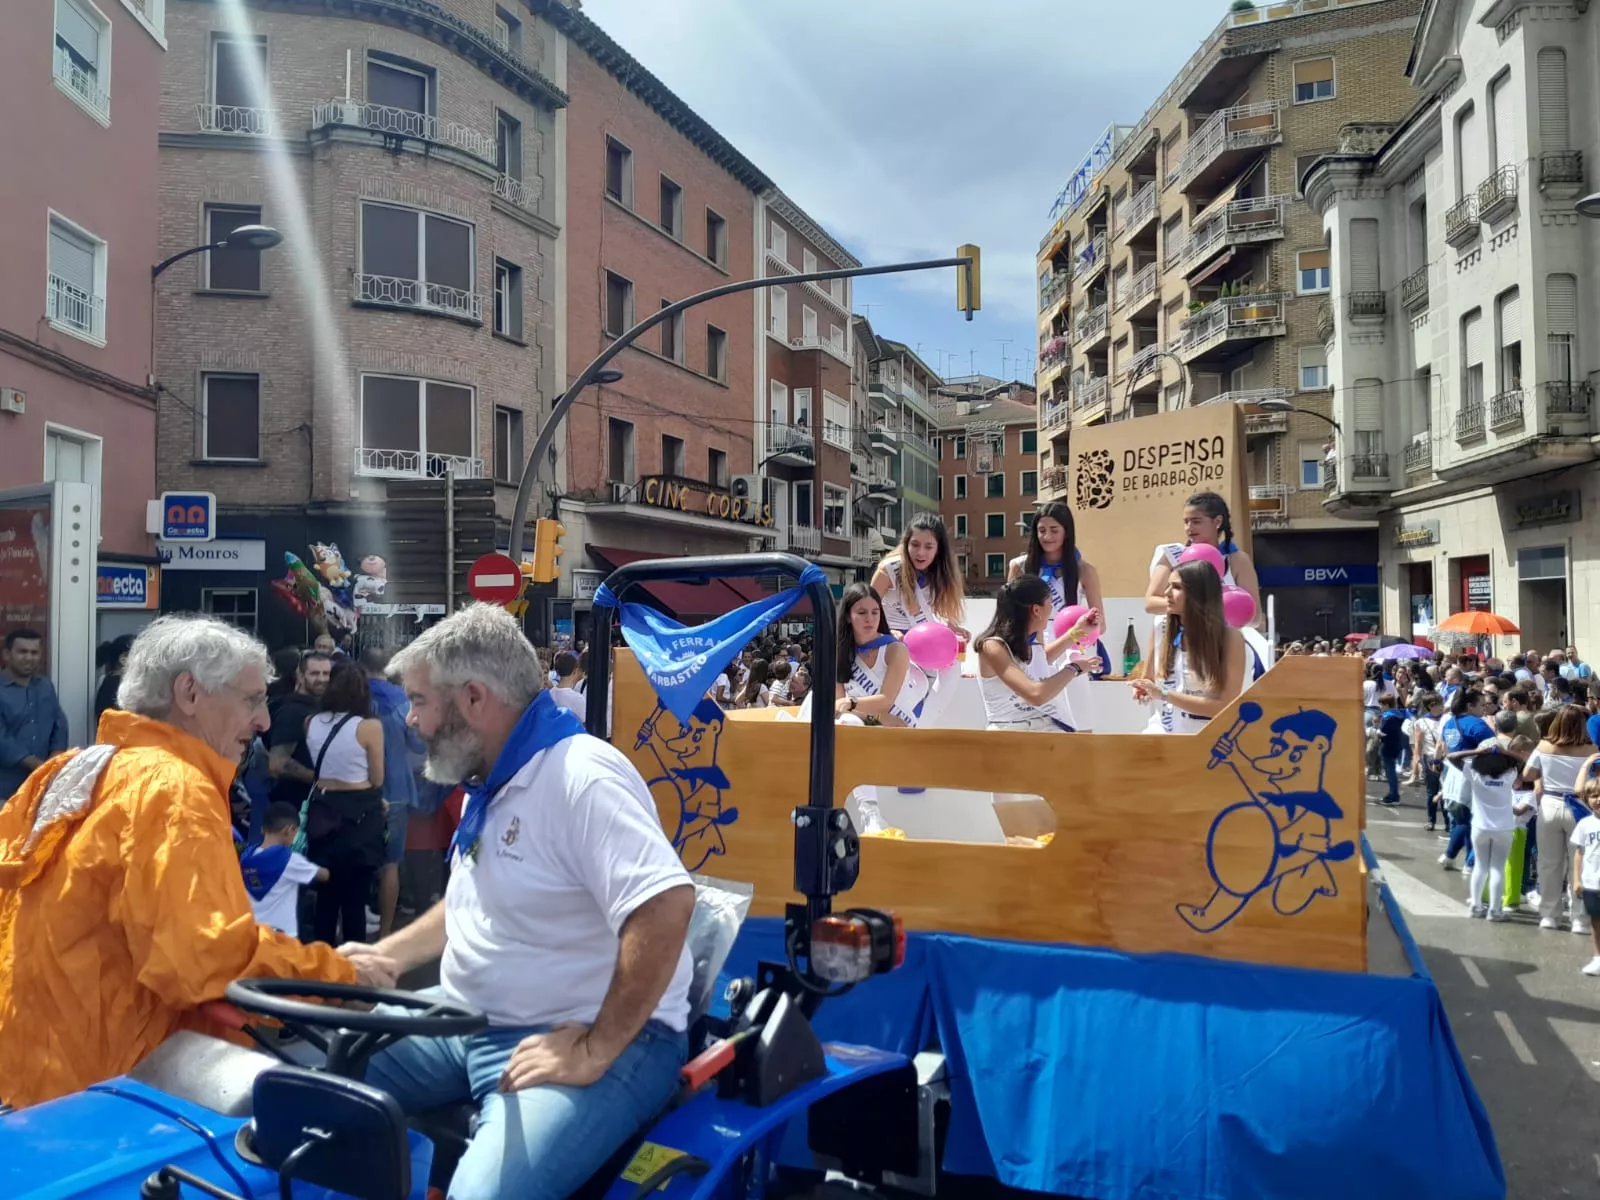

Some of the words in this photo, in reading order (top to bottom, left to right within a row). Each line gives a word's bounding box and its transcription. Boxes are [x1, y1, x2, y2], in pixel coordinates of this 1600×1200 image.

[1123, 435, 1225, 472] DESPENSA
[1123, 476, 1139, 491] DE
[1143, 462, 1224, 489] BARBASTRO
[646, 478, 690, 512] CINE
[179, 546, 239, 560] Monros
[1304, 567, 1348, 580] BBVA
[672, 637, 720, 650] FERRA
